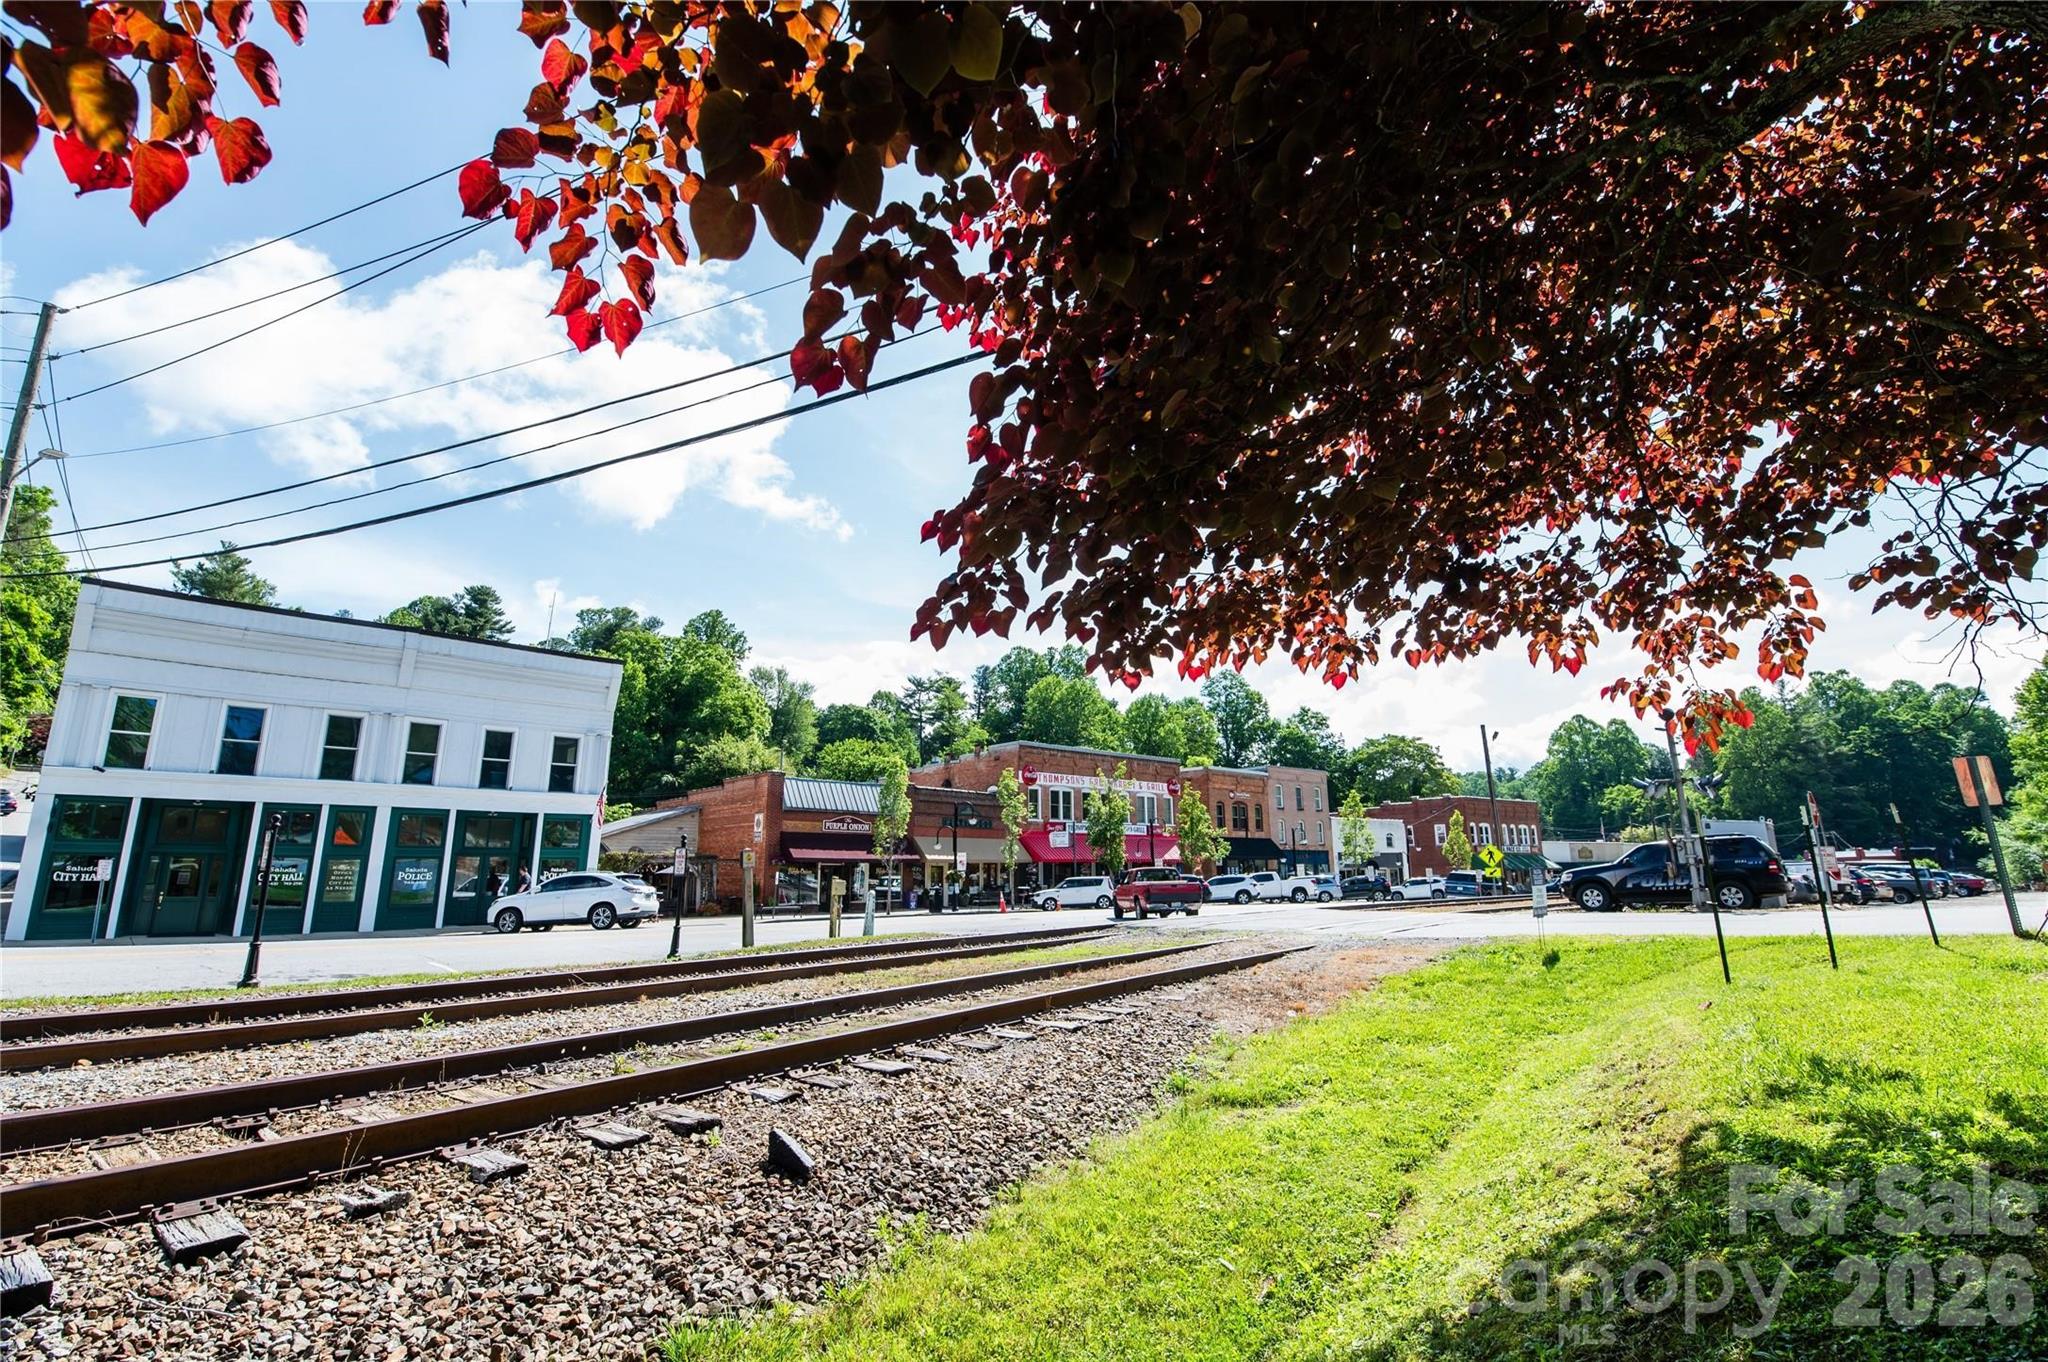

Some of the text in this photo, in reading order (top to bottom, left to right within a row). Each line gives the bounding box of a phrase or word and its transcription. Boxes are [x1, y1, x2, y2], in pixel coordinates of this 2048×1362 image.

[825, 822, 870, 831] PURPLE ONION
[53, 871, 100, 881] CITY HA
[281, 872, 304, 881] HALL
[397, 871, 433, 880] POLICE
